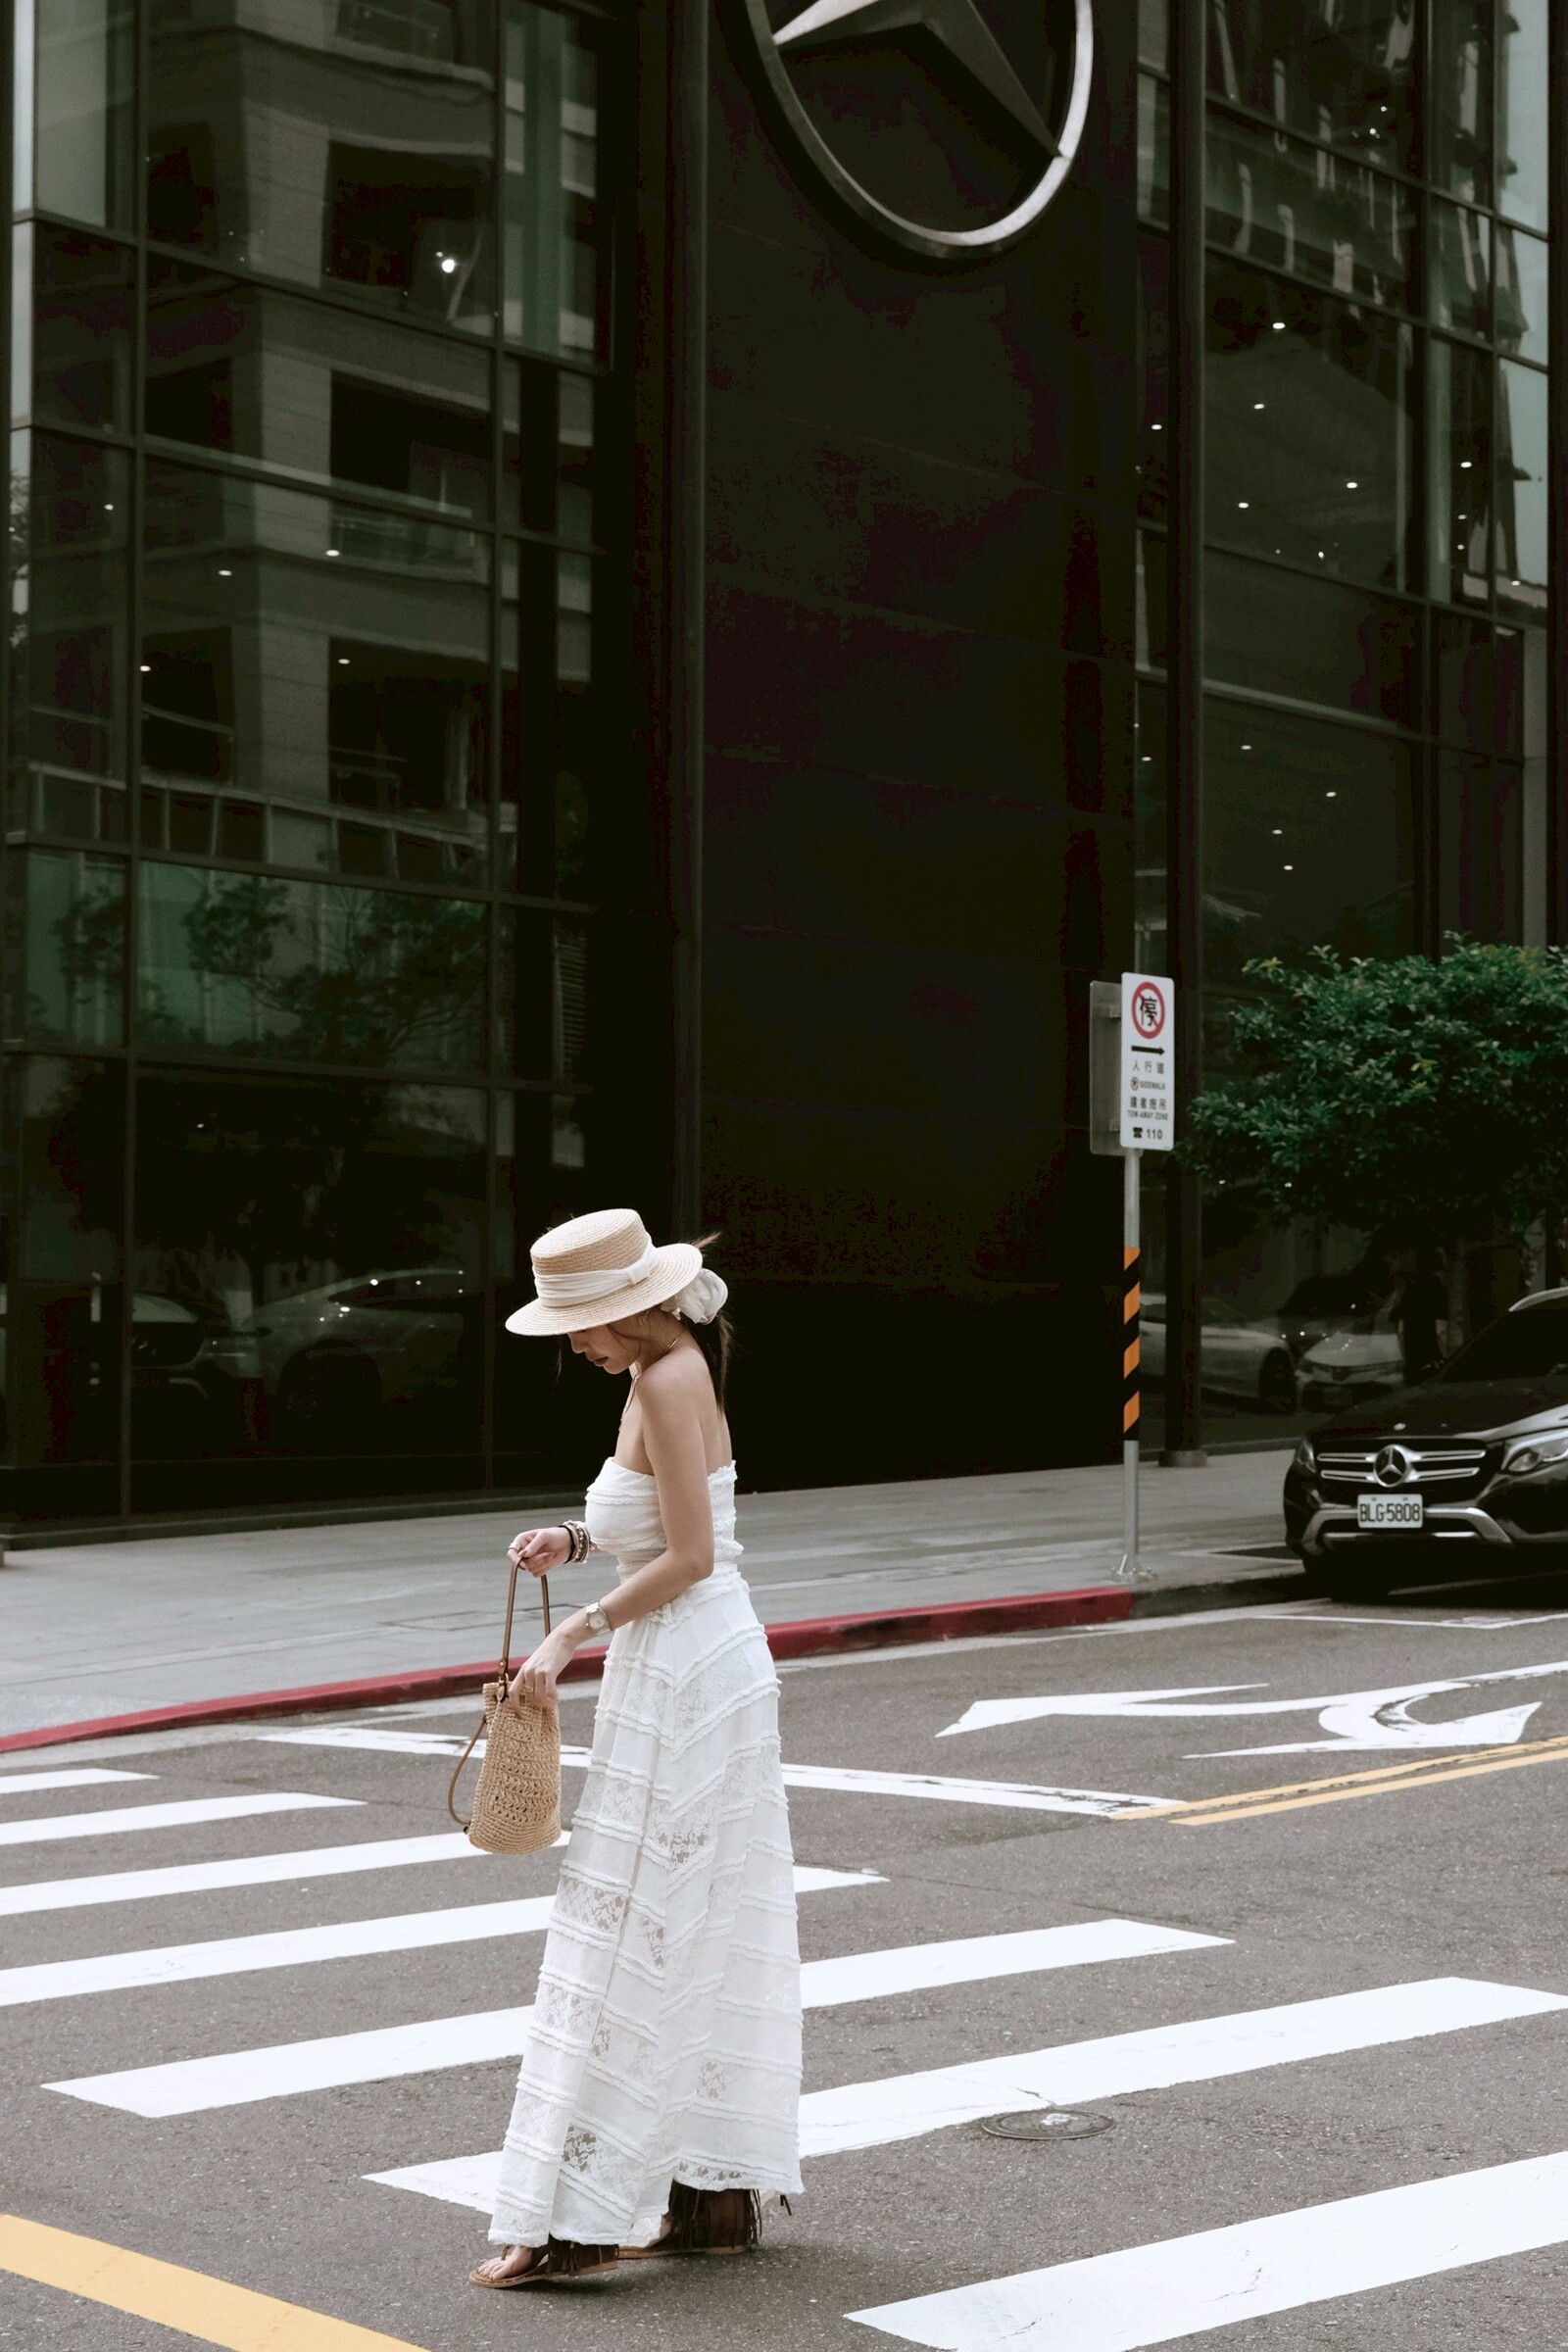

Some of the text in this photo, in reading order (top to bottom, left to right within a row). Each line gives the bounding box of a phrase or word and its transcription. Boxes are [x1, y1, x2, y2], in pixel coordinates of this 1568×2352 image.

[1140, 996, 1157, 1026] 停
[1132, 1059, 1164, 1074] 人行道
[1147, 1128, 1163, 1140] 110
[1359, 1503, 1421, 1522] BLG-5808
